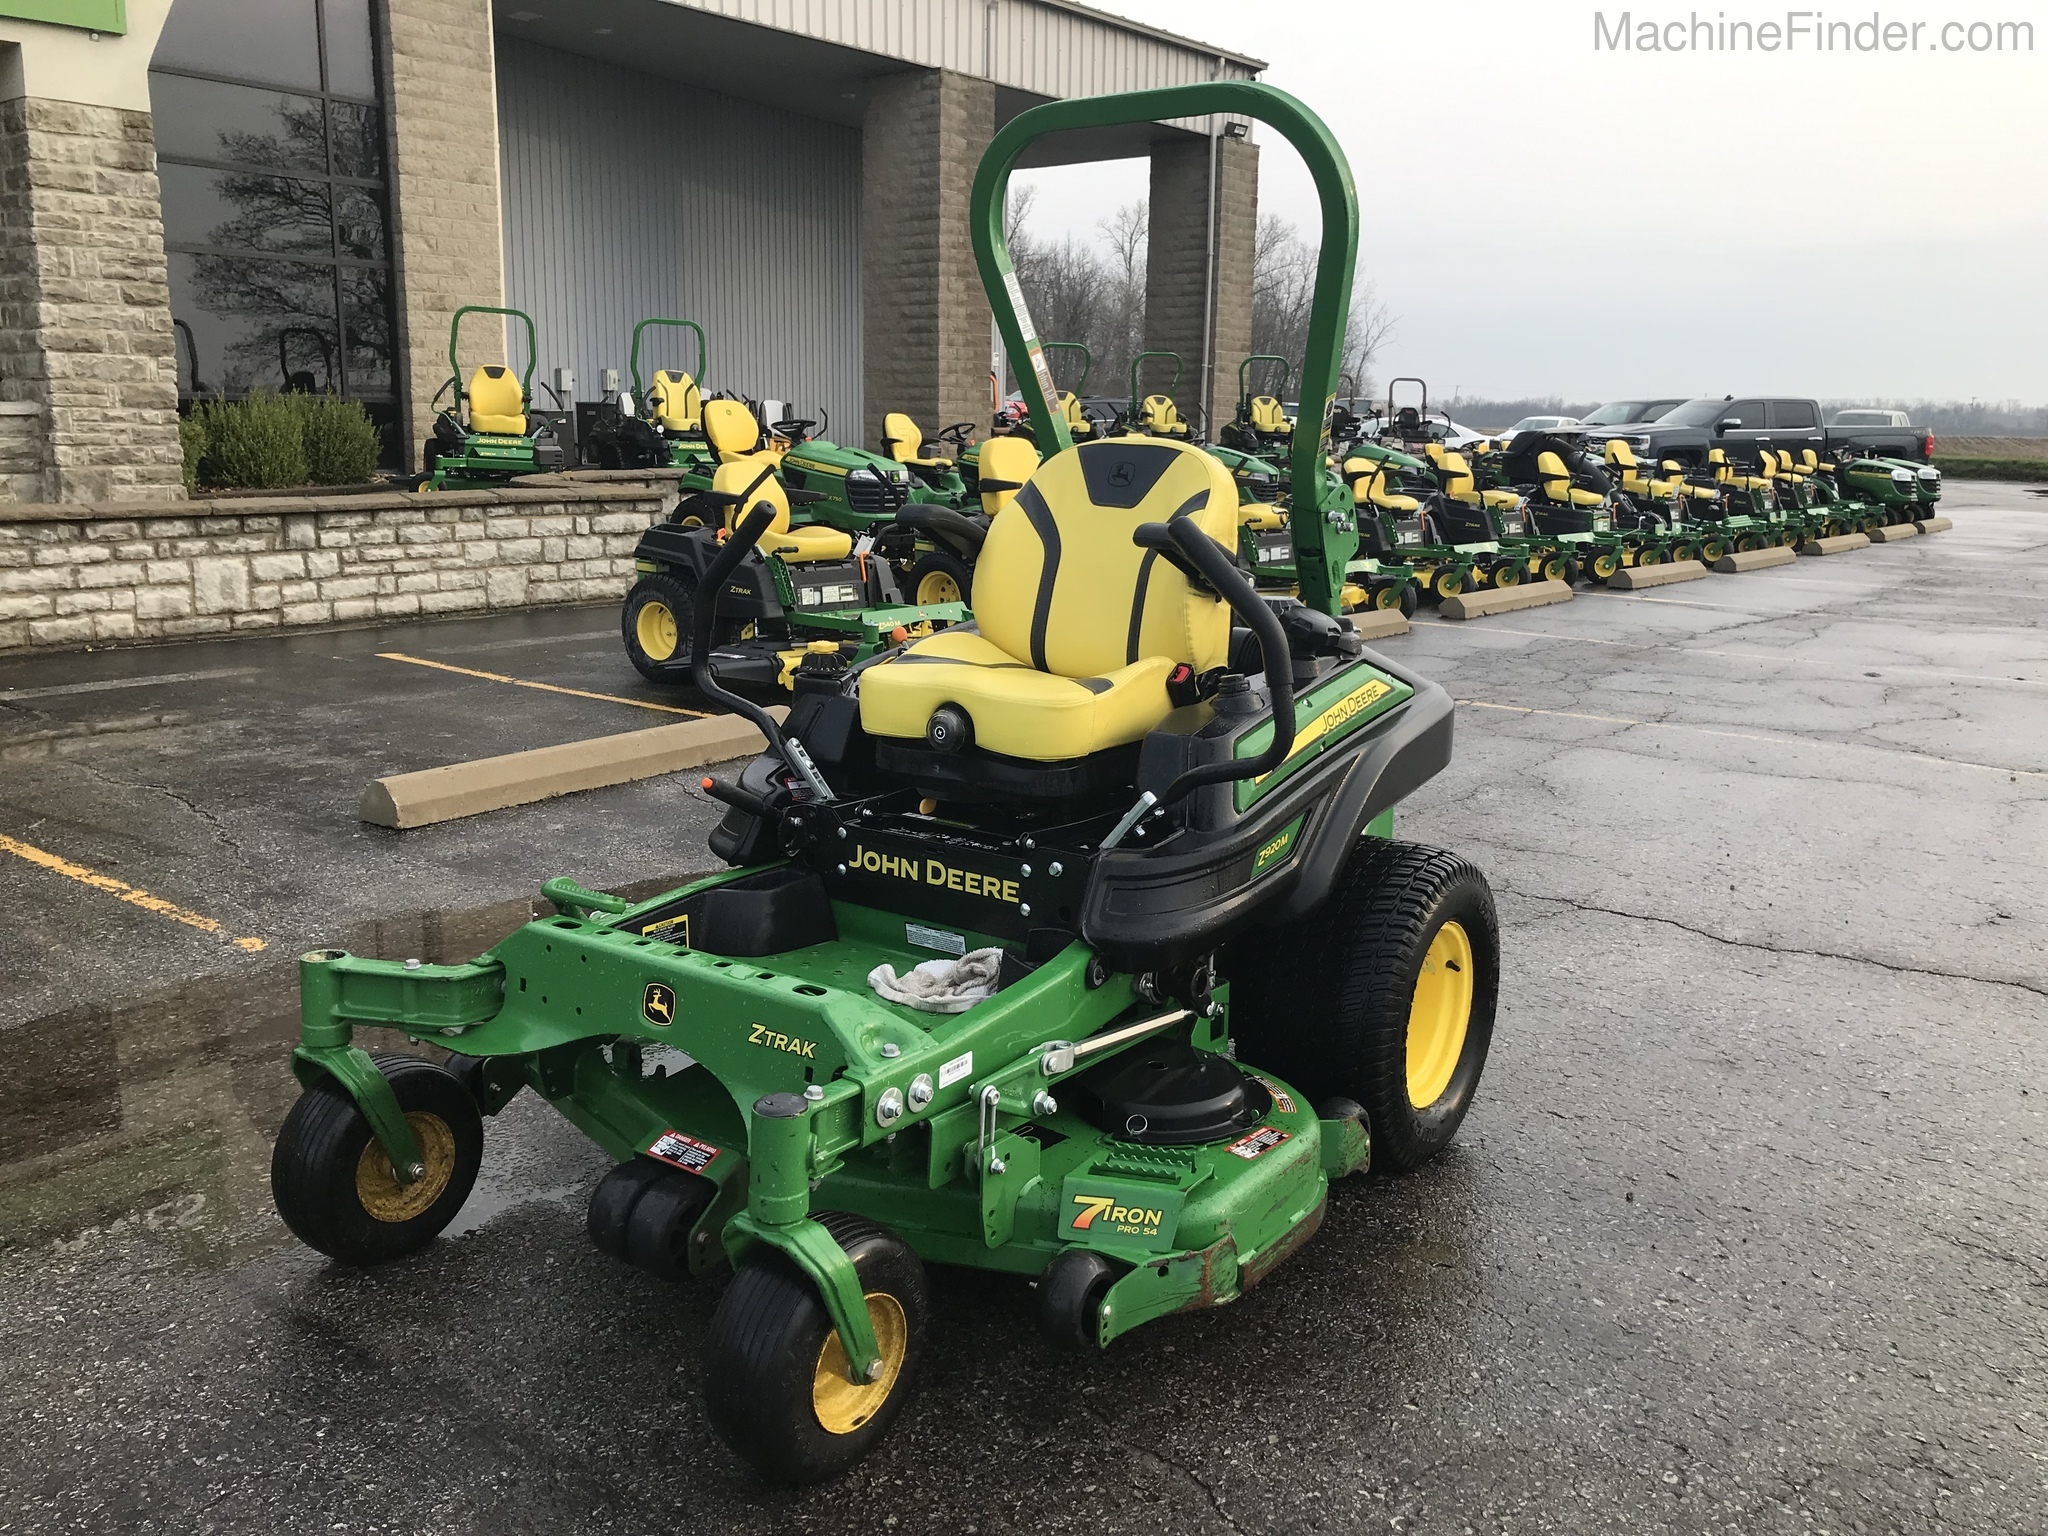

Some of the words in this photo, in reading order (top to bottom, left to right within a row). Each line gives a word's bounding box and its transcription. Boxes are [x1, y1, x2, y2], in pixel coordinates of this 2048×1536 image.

[730, 585, 752, 595] ZTRAK
[1321, 705, 1349, 732] JOHN
[1348, 685, 1380, 712] DEERE
[1257, 833, 1289, 867] Z920M
[848, 844, 919, 881] JOHN
[926, 859, 1020, 904] DEERE
[747, 1022, 818, 1059] ZTRAK
[1116, 1224, 1140, 1234] PRO
[1142, 1227, 1158, 1236] 54
